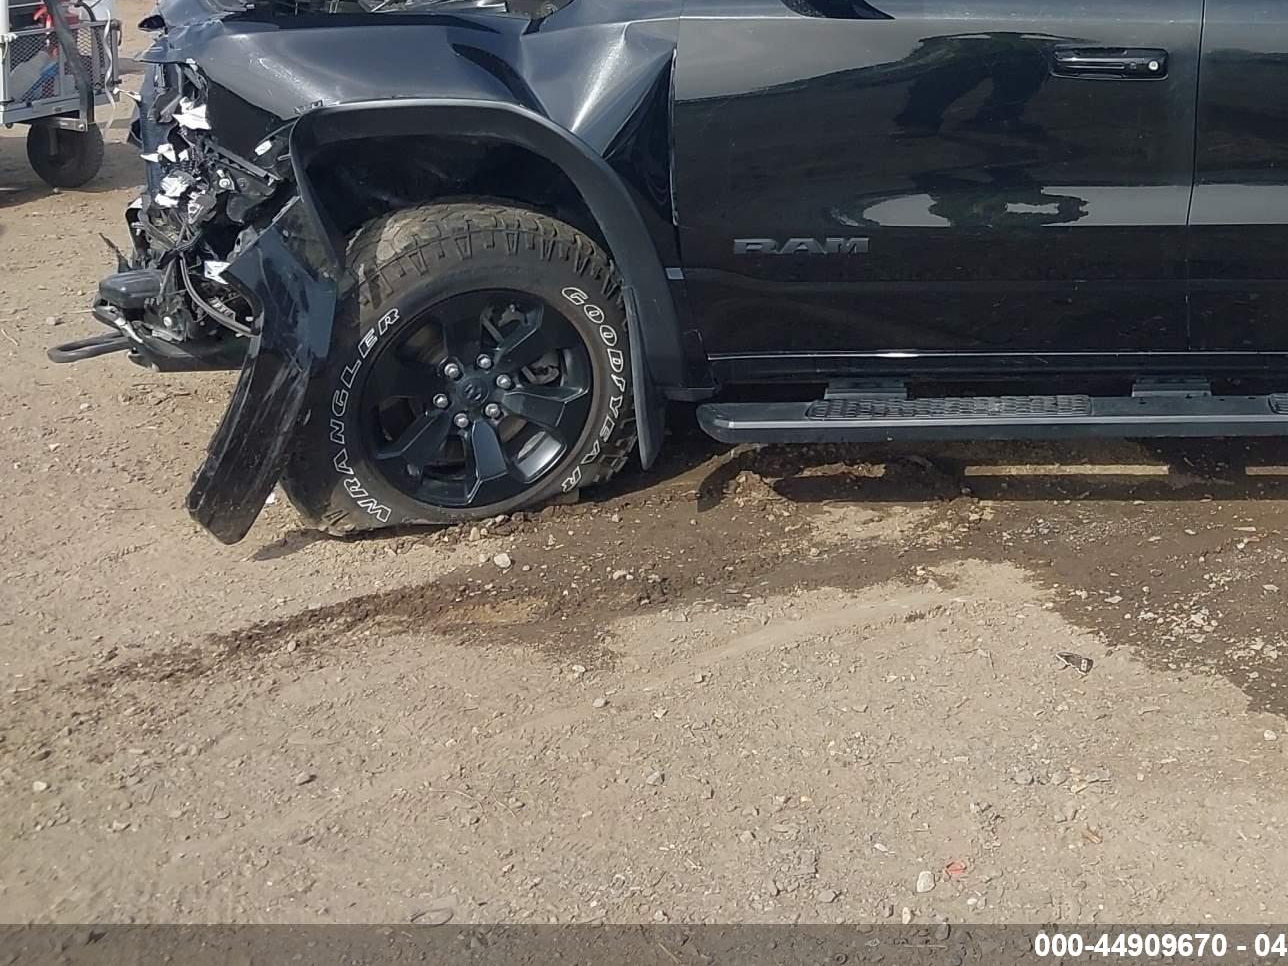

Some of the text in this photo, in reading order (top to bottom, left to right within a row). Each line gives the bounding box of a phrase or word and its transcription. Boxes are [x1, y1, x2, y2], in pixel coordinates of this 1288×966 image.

[734, 237, 869, 255] RAM
[329, 307, 400, 523] WRANGLER
[561, 286, 627, 494] GOODYEAR
